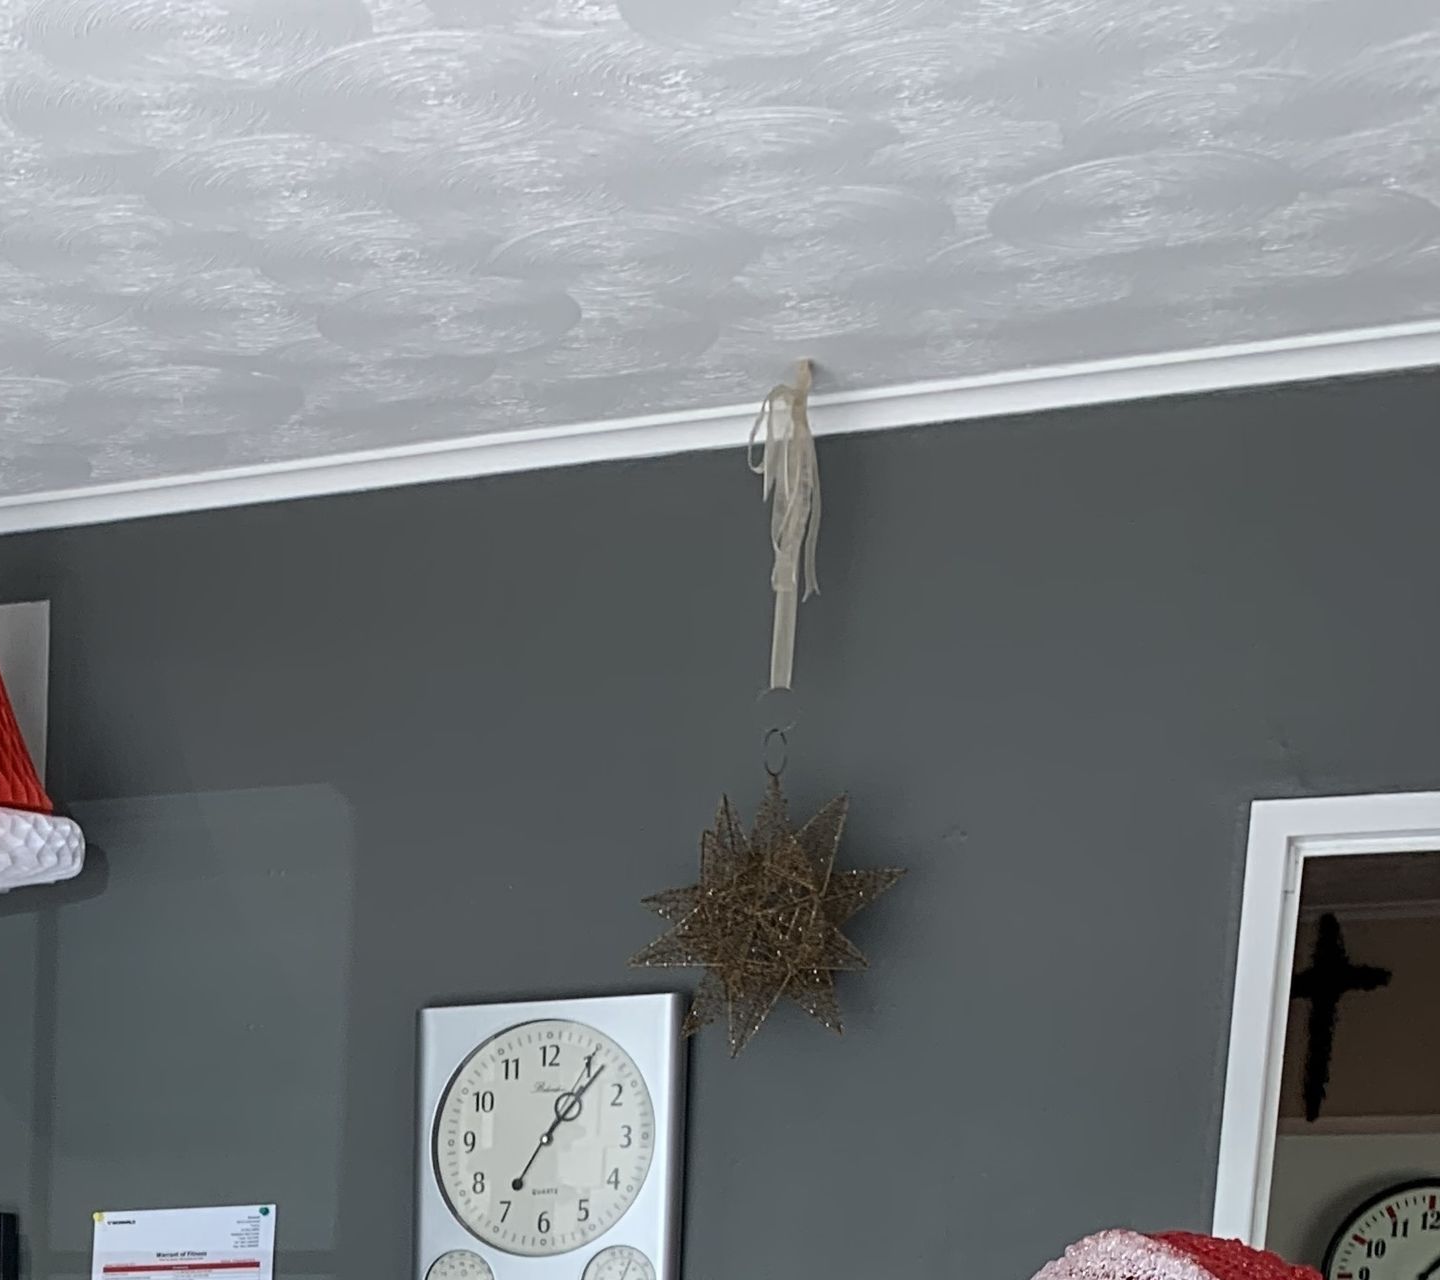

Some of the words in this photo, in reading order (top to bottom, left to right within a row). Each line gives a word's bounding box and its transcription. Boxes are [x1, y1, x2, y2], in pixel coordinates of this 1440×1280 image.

[539, 1044, 560, 1067] 12
[501, 1058, 520, 1080] 11
[472, 1090, 495, 1113] 10
[610, 1083, 623, 1106] 2
[463, 1131, 476, 1154] 9
[619, 1125, 632, 1148] 3
[472, 1171, 485, 1194] 8
[606, 1167, 621, 1190] 4
[499, 1200, 511, 1223] 7
[577, 1199, 590, 1222] 5
[1421, 1210, 1440, 1231] 12
[537, 1211, 550, 1234] 6
[1391, 1218, 1409, 1238] 11
[1366, 1239, 1386, 1258] 10
